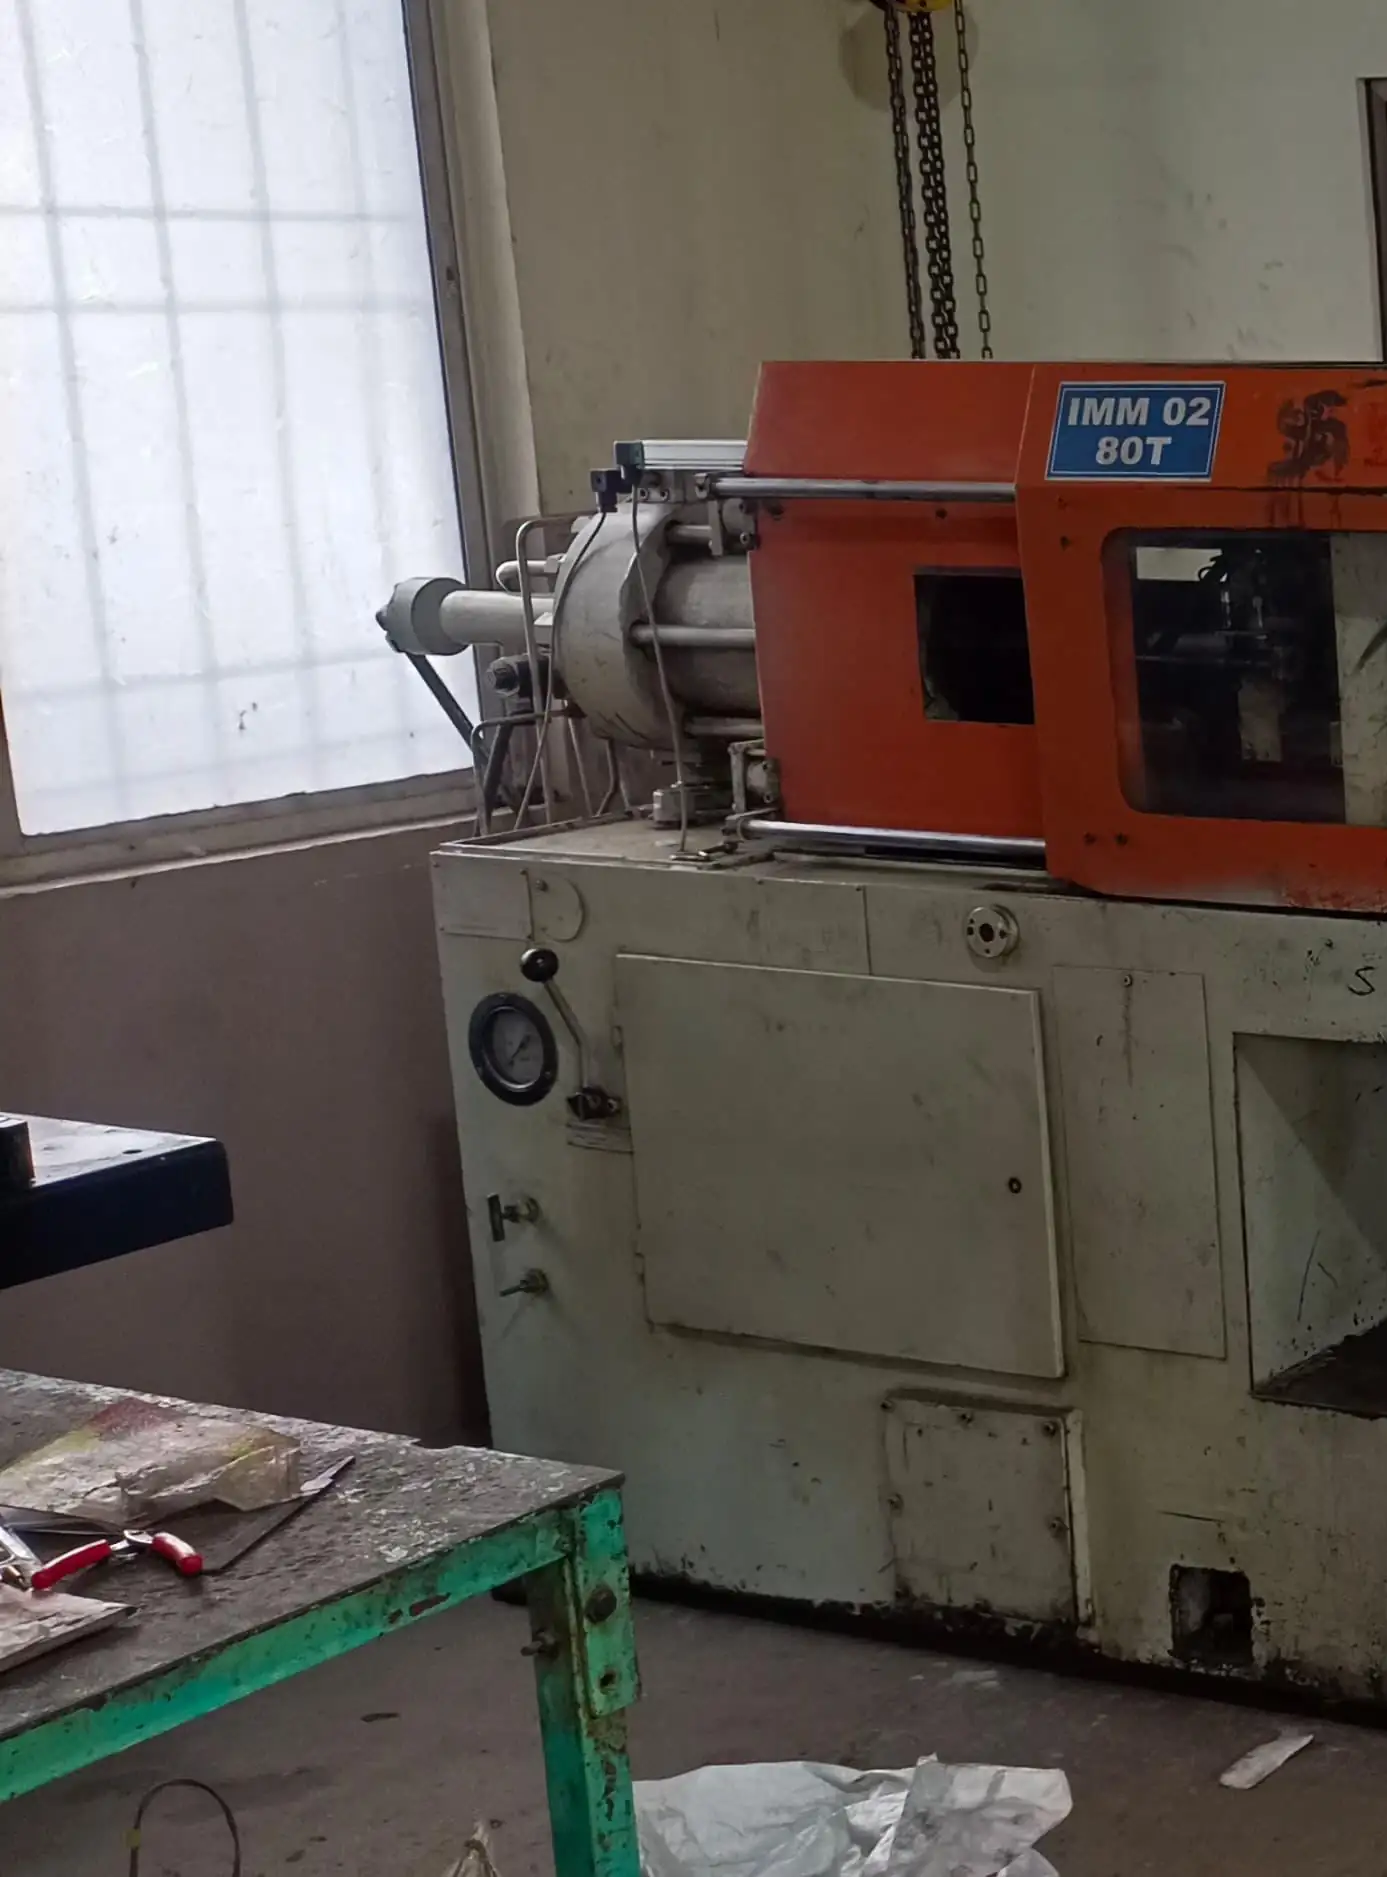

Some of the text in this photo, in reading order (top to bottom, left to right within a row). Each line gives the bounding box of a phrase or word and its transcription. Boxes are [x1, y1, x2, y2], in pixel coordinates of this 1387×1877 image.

[1067, 396, 1210, 427] IMM 02
[1095, 436, 1173, 466] 80T
